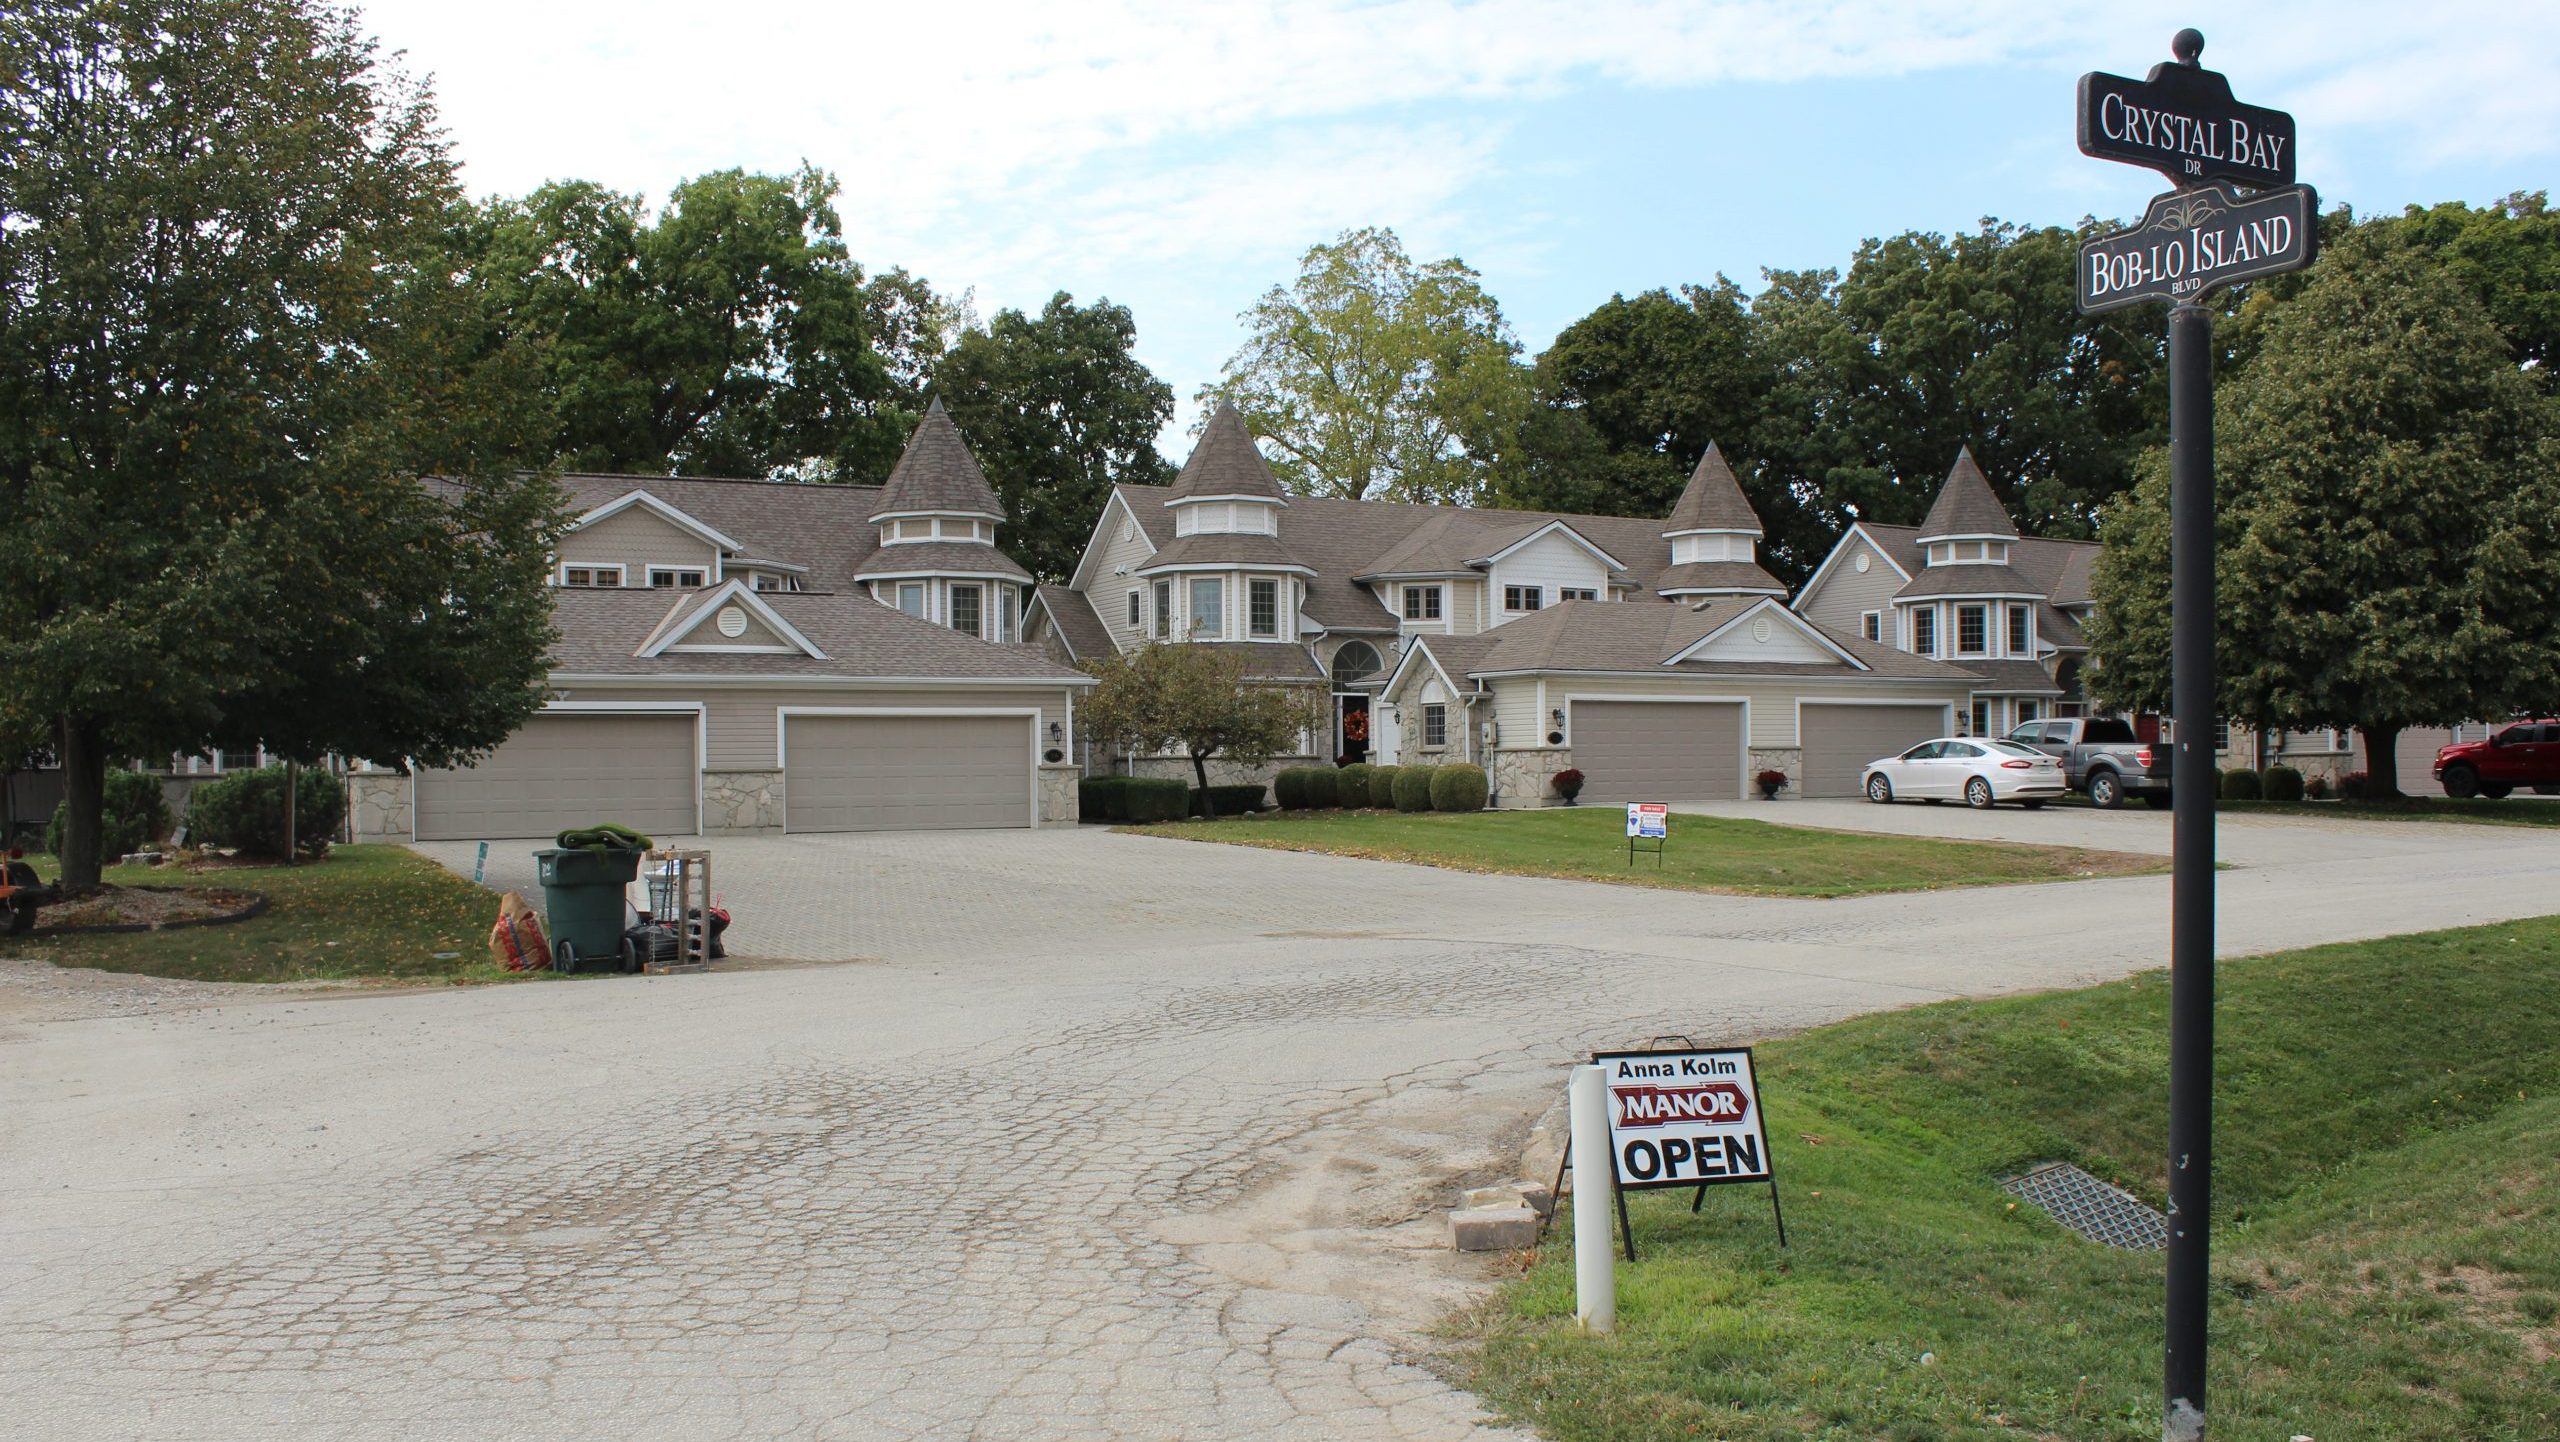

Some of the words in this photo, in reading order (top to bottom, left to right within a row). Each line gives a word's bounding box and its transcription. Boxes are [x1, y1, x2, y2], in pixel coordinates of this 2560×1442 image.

[2101, 92, 2225, 160] CRYSTAL
[2229, 118, 2286, 172] BAY
[2185, 159, 2203, 176] DR
[2090, 240, 2185, 297] BOB-LO
[2190, 215, 2292, 274] ISLAND
[2171, 277, 2201, 295] BLVD
[1618, 1061, 1675, 1078] Anna
[1681, 1058, 1737, 1076] Kolm
[1625, 1091, 1741, 1120] MANOR
[1623, 1134, 1761, 1181] OPEN
